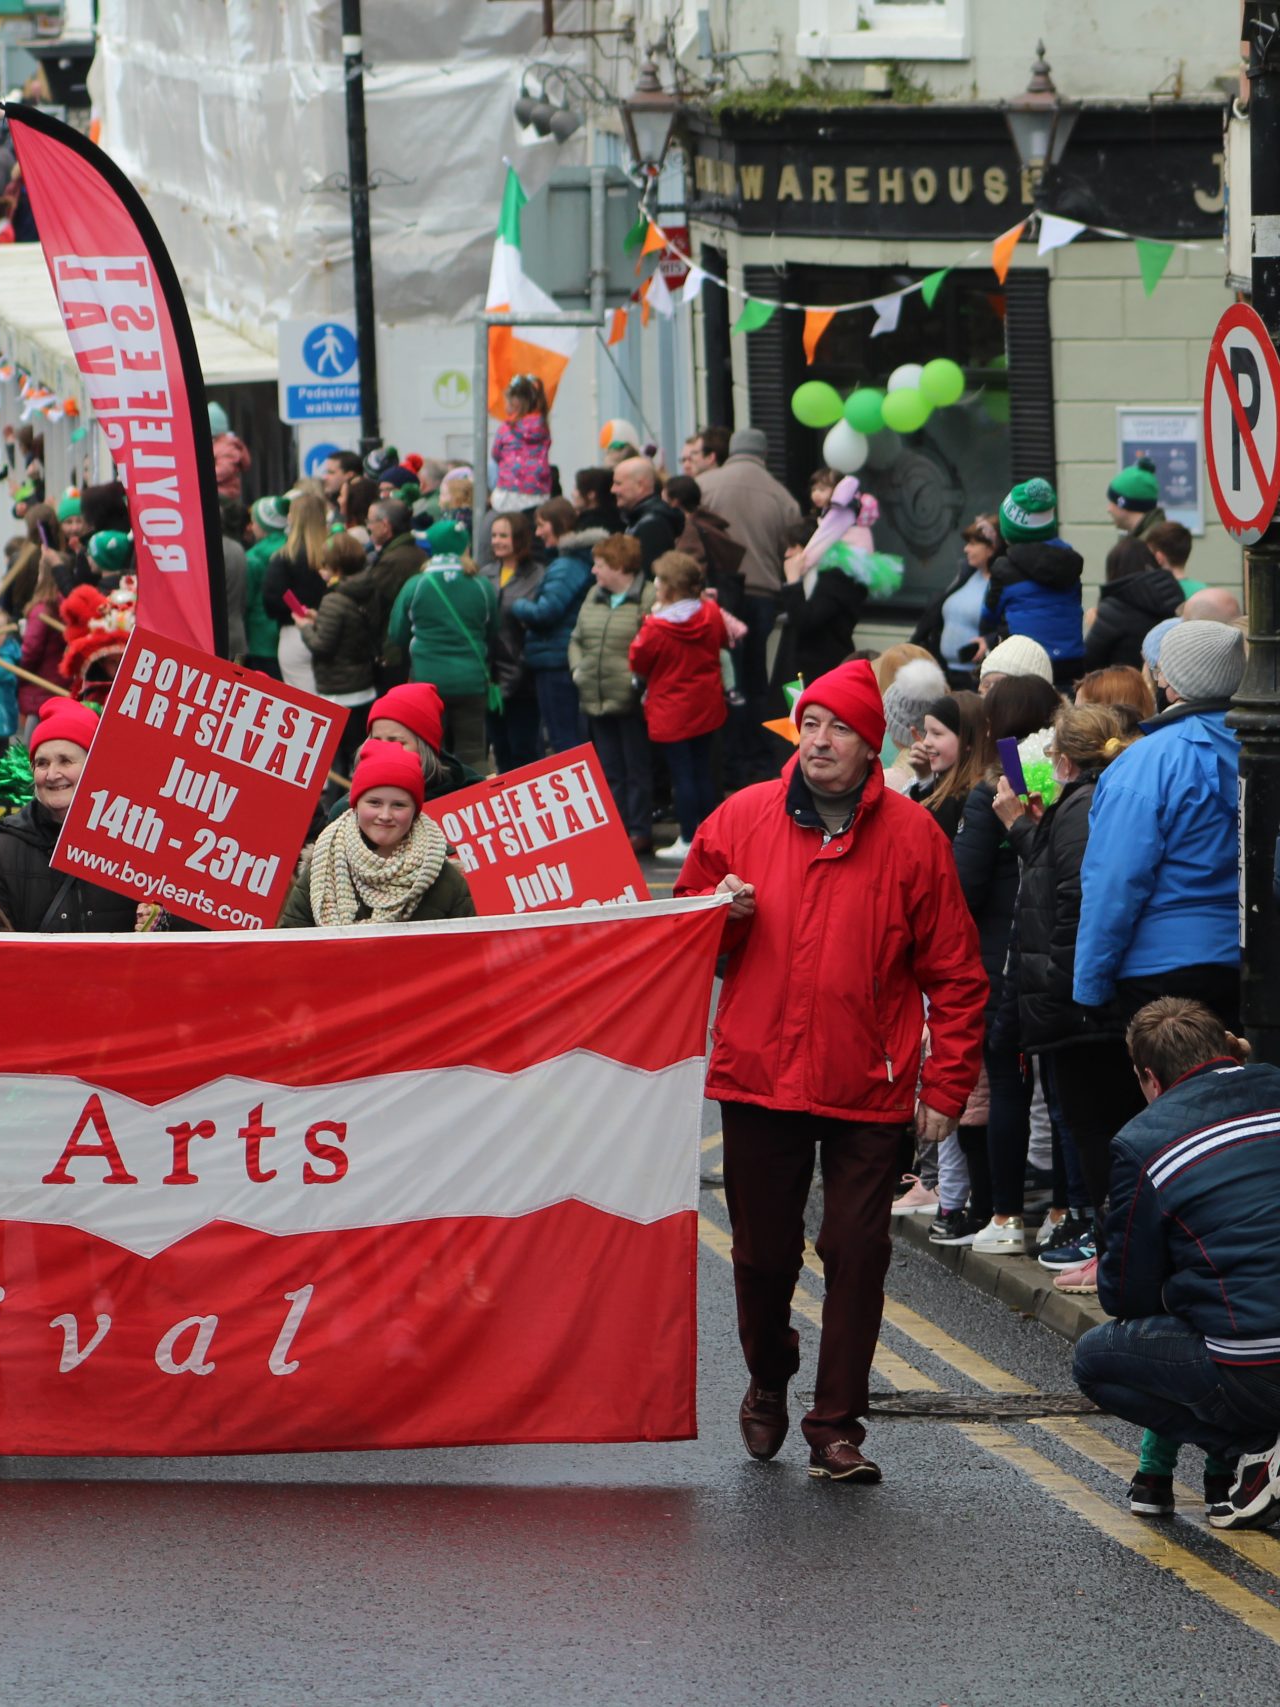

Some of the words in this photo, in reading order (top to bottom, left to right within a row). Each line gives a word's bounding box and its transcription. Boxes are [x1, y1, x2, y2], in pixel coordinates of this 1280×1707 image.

[298, 386, 360, 399] Pedestria
[305, 402, 357, 415] walkway
[158, 757, 239, 823] July
[86, 789, 165, 854] 14th
[185, 828, 281, 897] 23rd
[66, 844, 263, 930] www.boylearts.com
[505, 862, 573, 913] July
[42, 1093, 350, 1186] Arts
